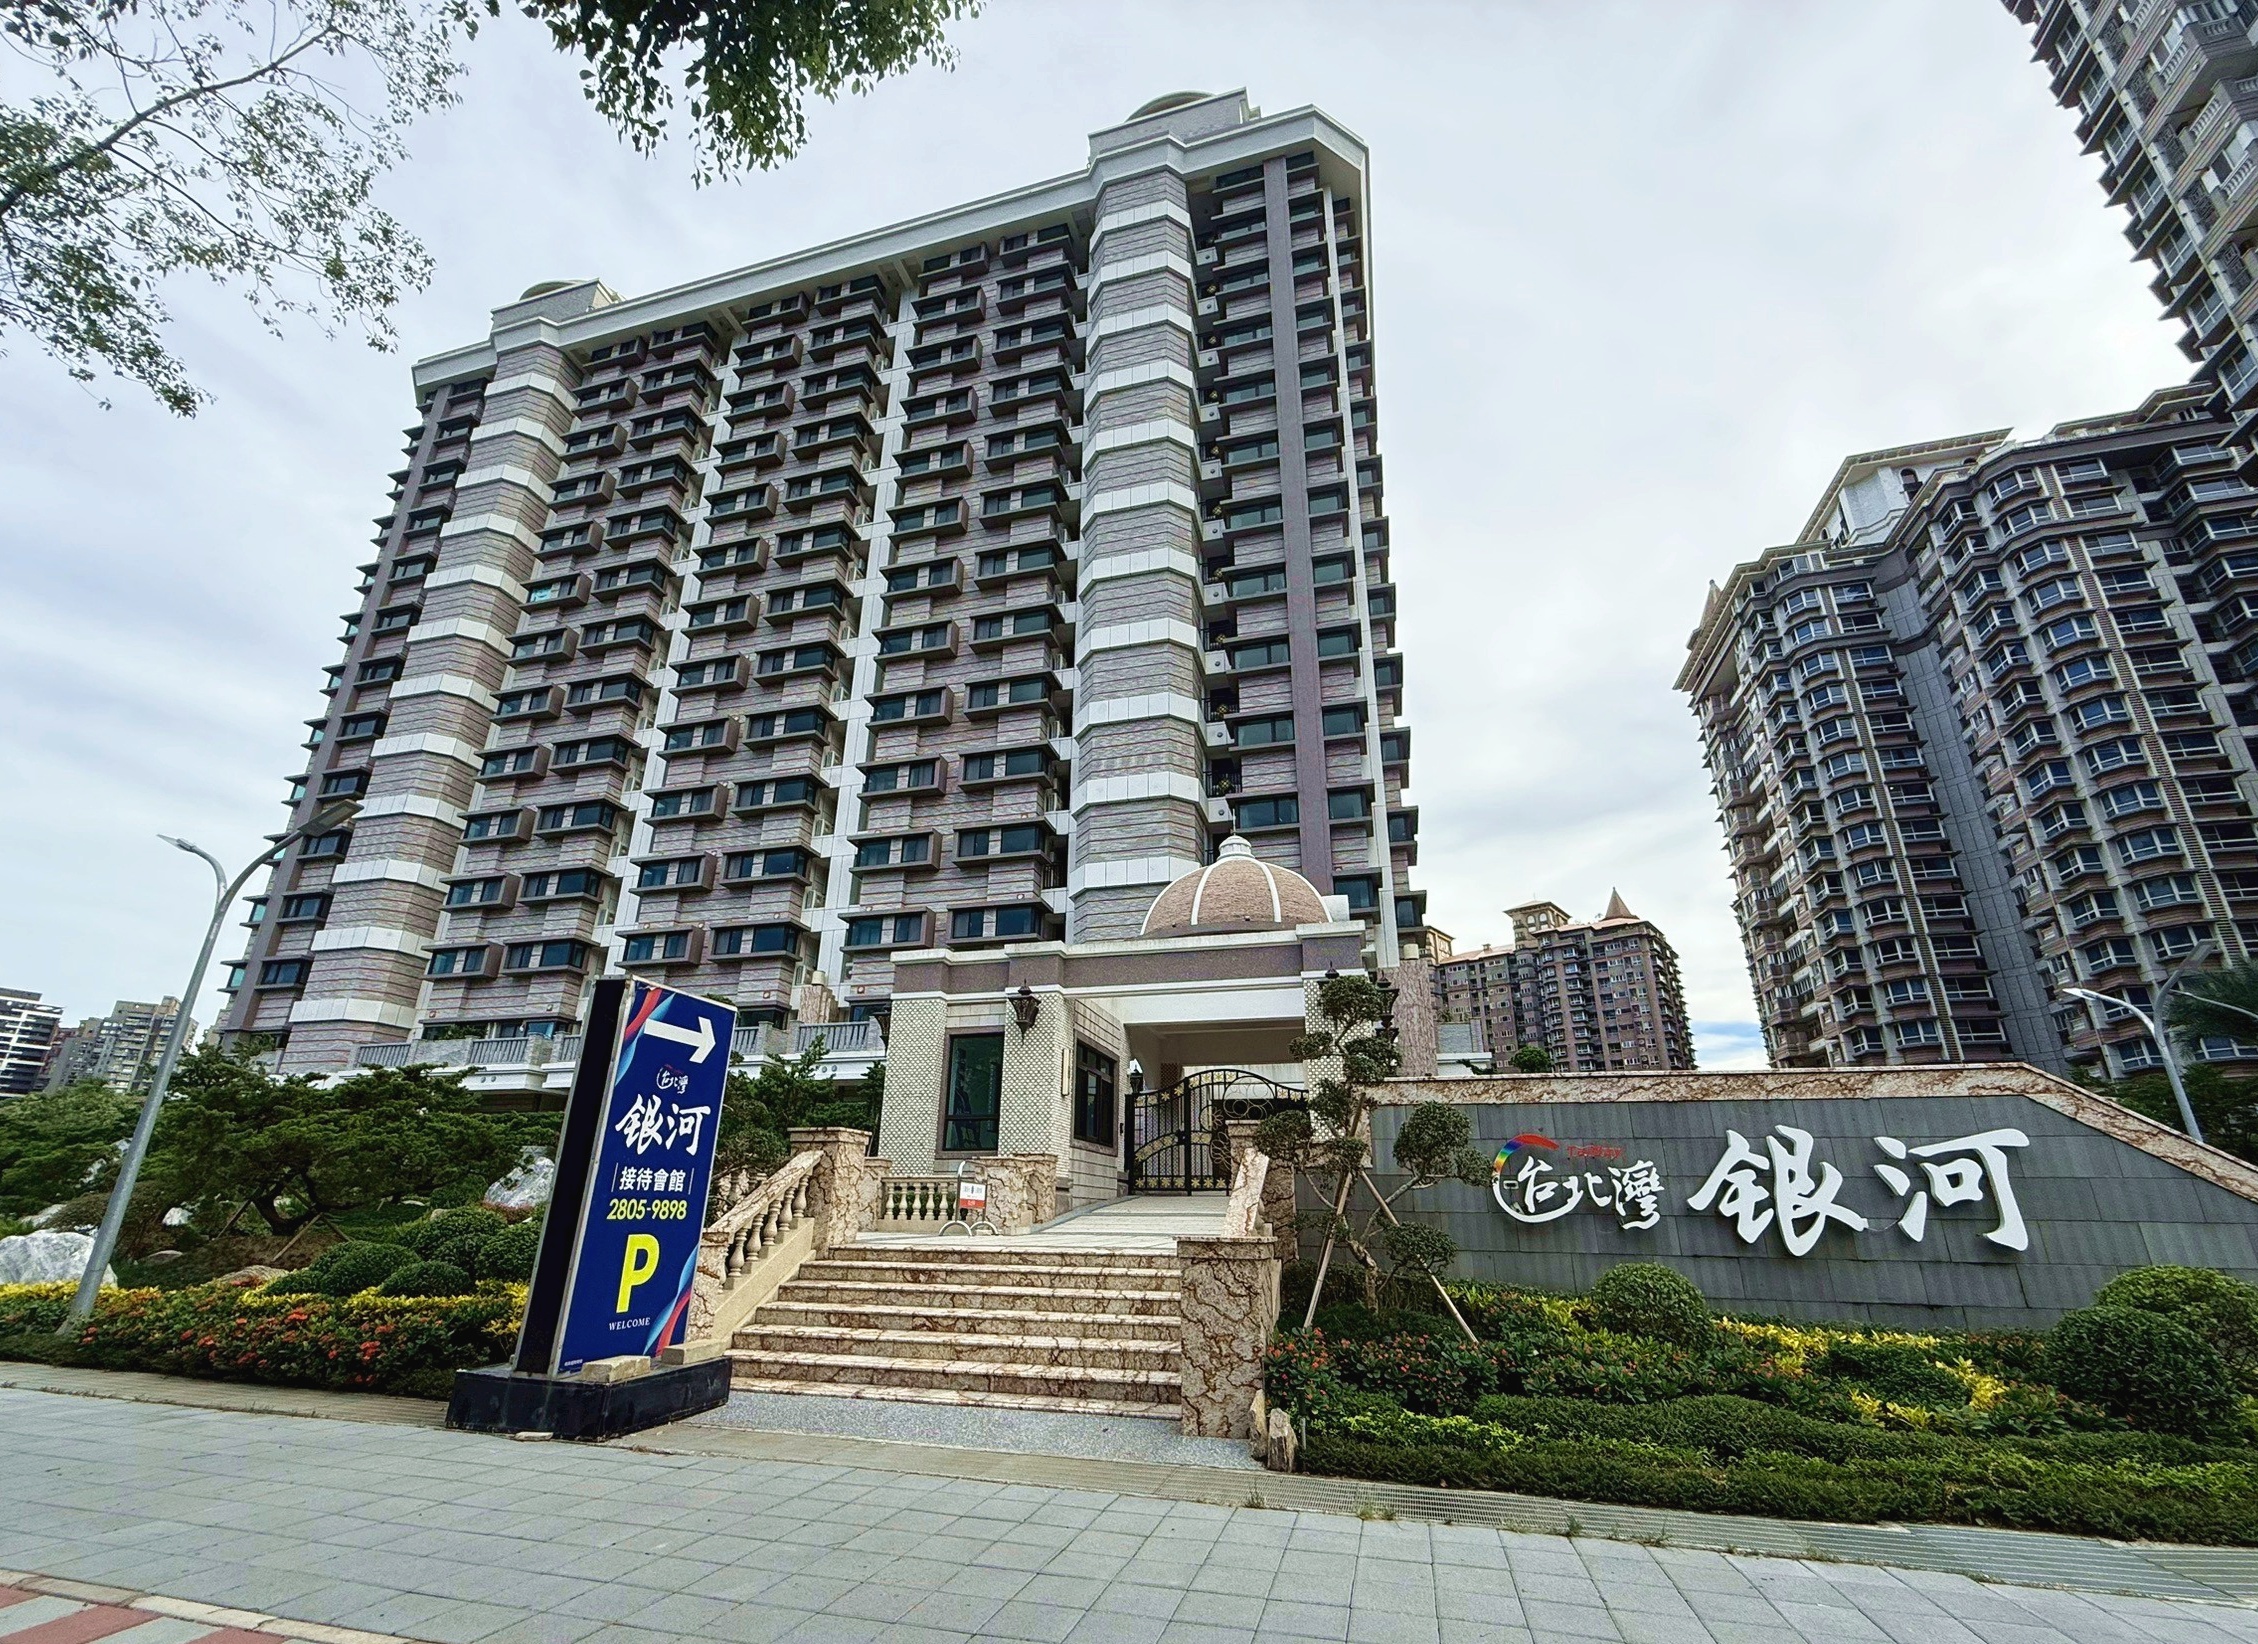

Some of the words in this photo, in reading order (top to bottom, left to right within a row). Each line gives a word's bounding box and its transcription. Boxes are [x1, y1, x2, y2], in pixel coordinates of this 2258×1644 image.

[656, 1067, 688, 1094] 台北灣
[615, 1093, 711, 1156] 銀河
[618, 1166, 686, 1192] 接待會館
[1493, 1146, 1664, 1230] 台北灣
[1687, 1124, 2030, 1257] 銀河
[606, 1198, 688, 1220] 2805-9898
[616, 1233, 660, 1313] P
[608, 1317, 650, 1331] WELCOME
